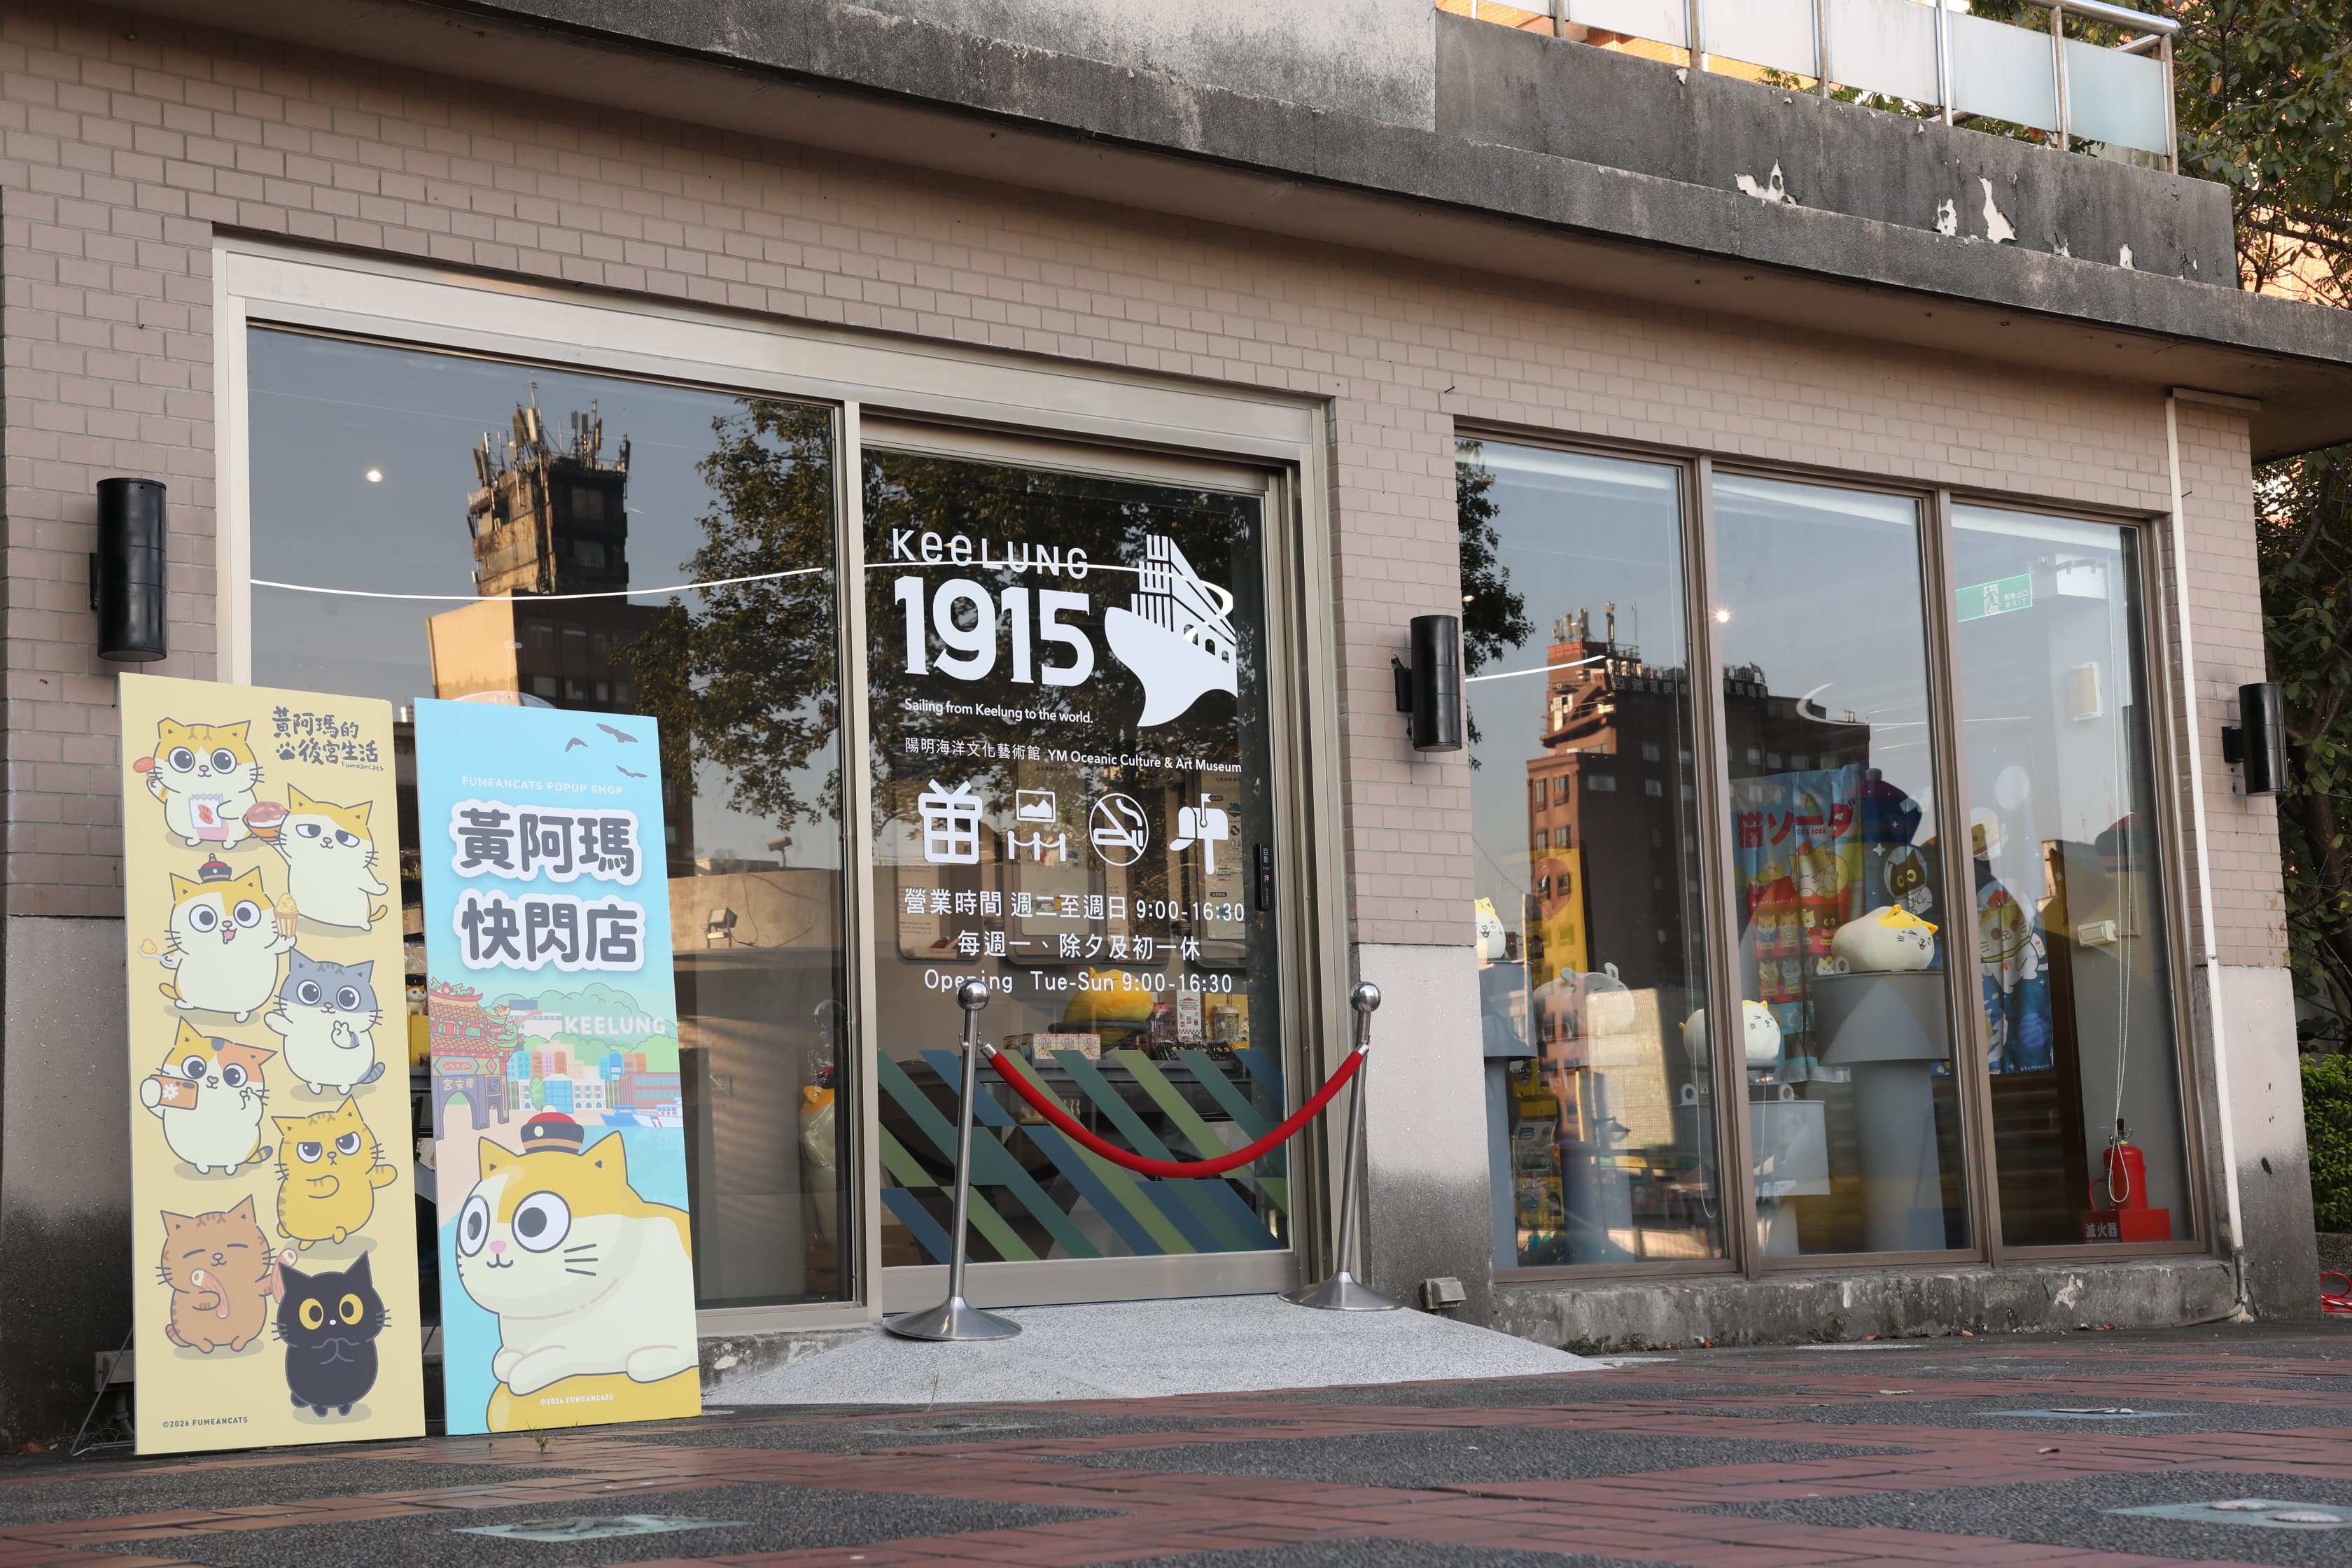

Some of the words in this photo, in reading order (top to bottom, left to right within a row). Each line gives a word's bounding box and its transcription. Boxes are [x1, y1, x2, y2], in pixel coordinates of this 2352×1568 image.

[2005, 598, 2027, 608] EXIT
[895, 575, 1095, 687] 1915
[904, 698, 944, 716] Sailing
[945, 700, 973, 715] from
[975, 702, 1023, 722] Keelung
[1024, 708, 1036, 720] to
[1038, 707, 1057, 722] the
[1058, 709, 1093, 724] world.
[298, 737, 378, 765] 後宮生活
[905, 737, 1040, 762] 陽明海洋文化藝術館
[1047, 749, 1068, 762] YM
[1070, 750, 1117, 766] Oceanic
[1120, 753, 1161, 769] Culture
[1164, 757, 1172, 769] &
[1175, 757, 1193, 770] Art
[1196, 759, 1242, 773] Museum
[341, 761, 384, 771] Fumeancats
[462, 776, 542, 790] FUMEANCATS
[547, 782, 587, 793] POPUP
[591, 784, 623, 795] SHOP
[458, 807, 634, 876] 黃阿瑪
[904, 888, 1002, 917] 營業時間
[1011, 892, 1127, 920] 週二至週日
[1136, 899, 1245, 922] 9:00-16:30
[461, 897, 638, 963] 快閃店
[958, 930, 1200, 961] 每週一、除夕及初一休
[1030, 971, 1114, 991] Tue-Sun
[1122, 972, 1232, 993] 9:00-16:30
[565, 1014, 666, 1035] KEELUNG
[2085, 1223, 2118, 1238] 滅火器
[566, 1394, 614, 1404] FUMEANCATS
[192, 1416, 248, 1427] FUMEANCATS
